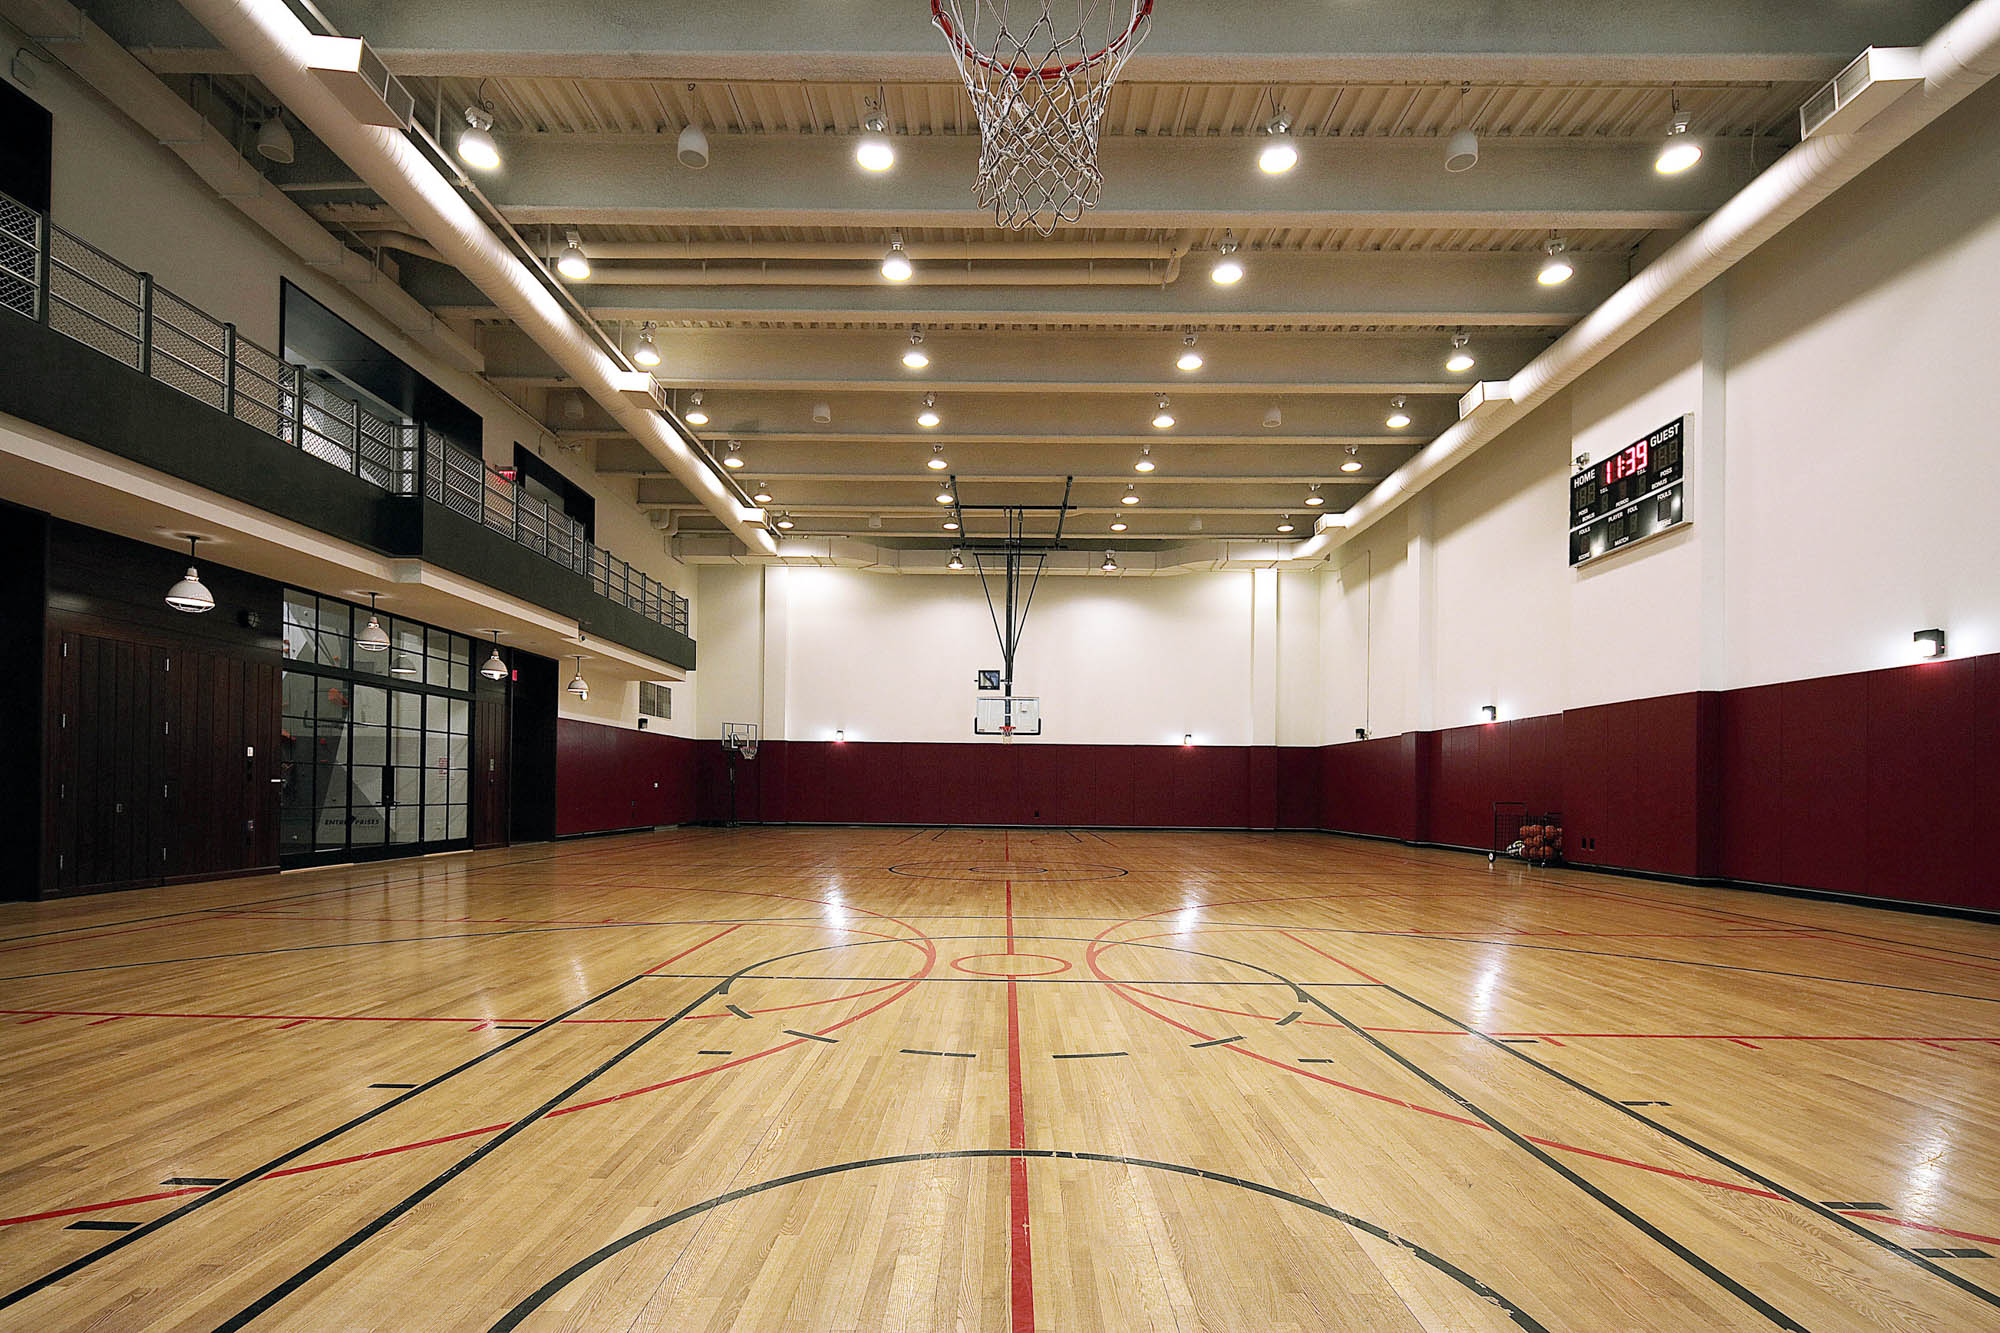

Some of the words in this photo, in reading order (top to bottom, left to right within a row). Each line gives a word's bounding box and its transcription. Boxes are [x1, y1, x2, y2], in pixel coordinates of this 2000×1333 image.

[1650, 423, 1680, 447] GUEST
[1606, 440, 1648, 485] 11:39
[1574, 469, 1596, 488] HOME
[1651, 478, 1667, 490] BONUS
[1657, 490, 1672, 501] FOULS
[1615, 497, 1630, 507] PERIOD
[1627, 505, 1639, 514] FOUL
[1582, 512, 1595, 522] BONUS
[1608, 512, 1624, 523] PLAYER
[1579, 527, 1591, 536] FOULS
[1614, 536, 1629, 547] MATCH
